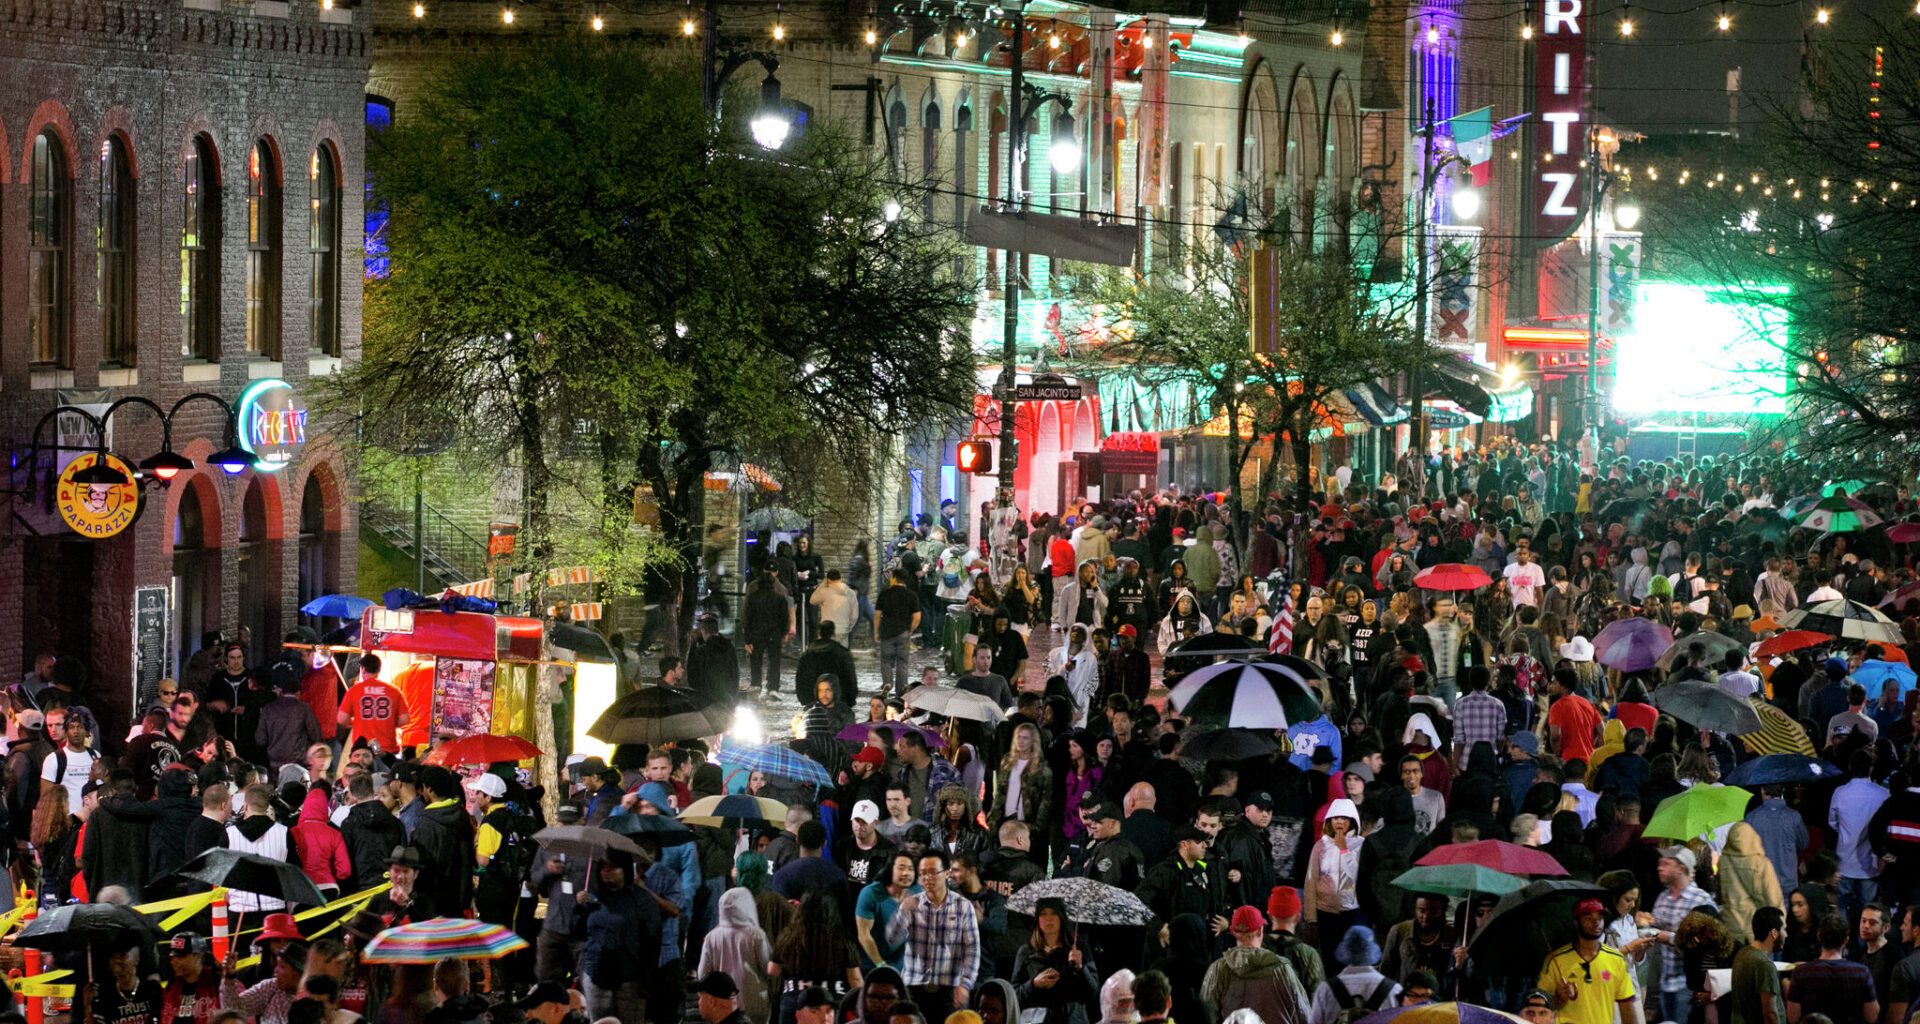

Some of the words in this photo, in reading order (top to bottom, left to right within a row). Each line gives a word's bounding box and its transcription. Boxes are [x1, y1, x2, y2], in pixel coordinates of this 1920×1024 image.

[1541, 0, 1582, 216] RITZ
[1018, 387, 1035, 397] SAN
[1036, 388, 1069, 398] JACINTO
[64, 505, 131, 534] PAPARAZZI
[360, 696, 391, 719] 88
[118, 1001, 151, 1016] TRUST
